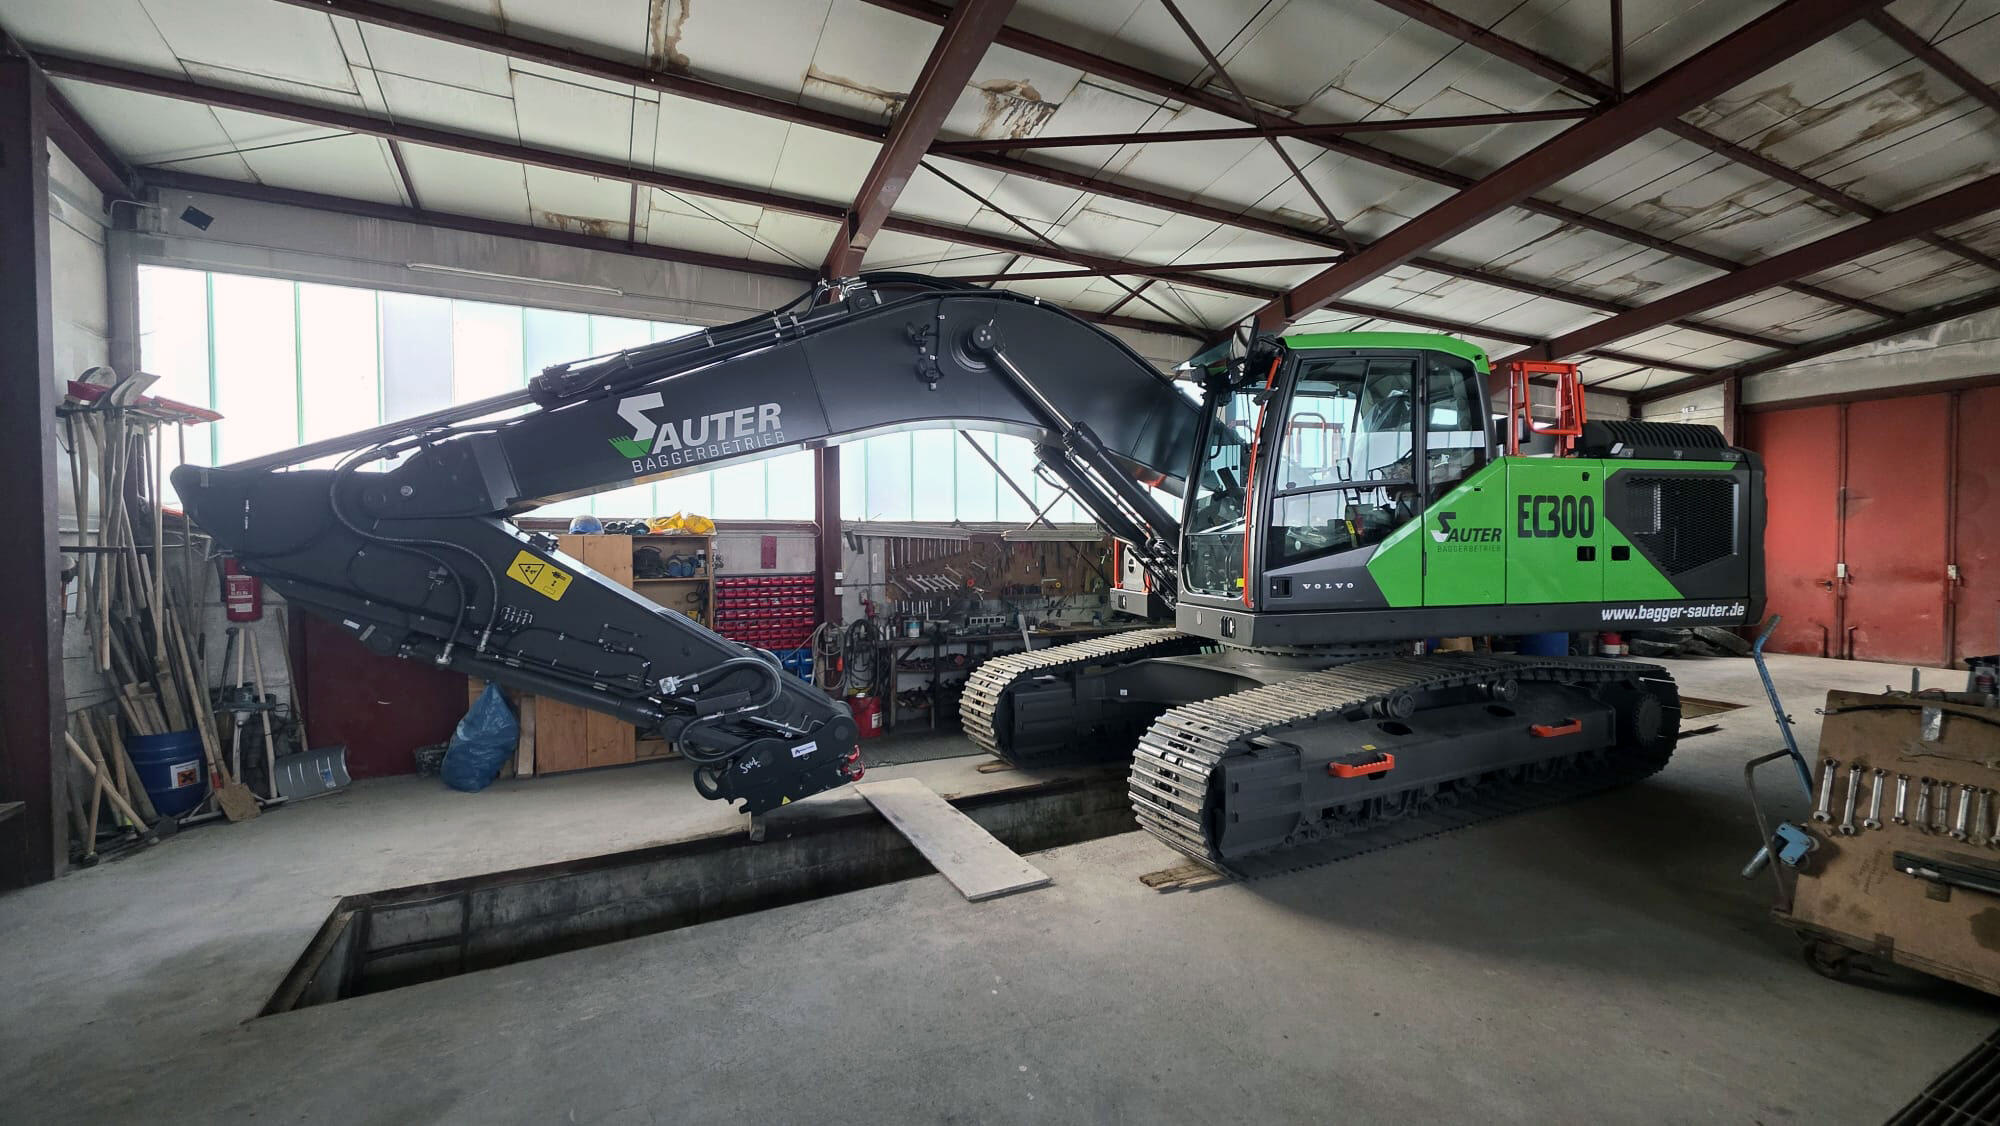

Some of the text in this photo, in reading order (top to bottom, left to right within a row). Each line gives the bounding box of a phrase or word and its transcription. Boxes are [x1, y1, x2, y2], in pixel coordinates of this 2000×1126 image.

[617, 392, 782, 455] SAUTER
[631, 431, 785, 473] BAGGERBETRIEB
[1437, 511, 1503, 543] SAUTER
[1517, 494, 1595, 539] EC300
[1302, 582, 1354, 590] VOLVO
[1601, 602, 1745, 623] www.bagger-sauter.de
